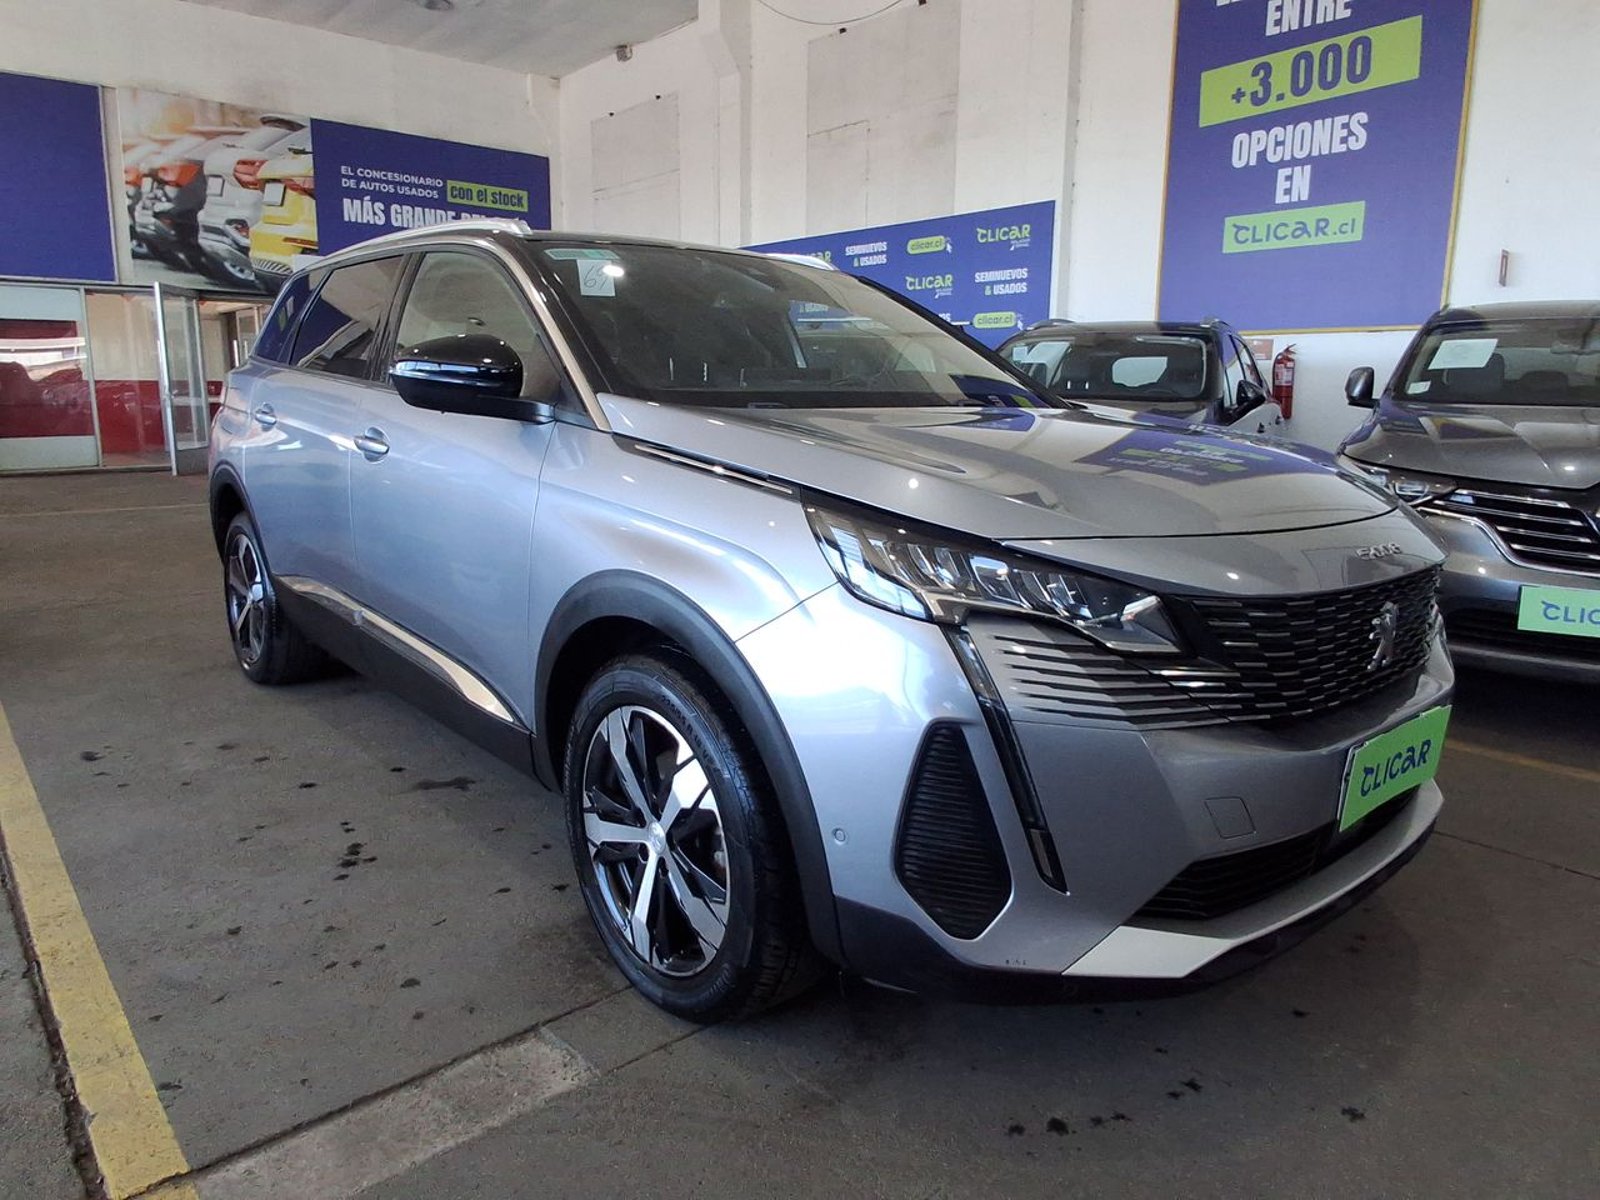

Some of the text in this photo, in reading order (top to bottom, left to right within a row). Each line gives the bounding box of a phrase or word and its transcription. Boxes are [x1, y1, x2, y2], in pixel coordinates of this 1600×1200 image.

[1265, 0, 1352, 36] ENTRE
[1231, 35, 1372, 107] +3.000
[1231, 112, 1369, 168] OPCIONES
[341, 165, 444, 188] EL CONCESIONARIO
[1275, 165, 1311, 204] EN
[341, 178, 439, 199] DE AUTOS USADOS
[450, 185, 524, 208] con el stock
[343, 195, 385, 226] MÁS
[911, 238, 944, 250] clicar.cl
[976, 224, 1031, 243] CLICAR
[845, 241, 888, 256] SEMINUEVOS
[860, 254, 888, 267] USADOS
[905, 274, 954, 291] CLICAR
[974, 267, 1029, 283] SEMINUEVOS
[993, 281, 1028, 295] USADOS
[977, 314, 1013, 326] clicar.cl
[1360, 740, 1432, 797] CLICAR
